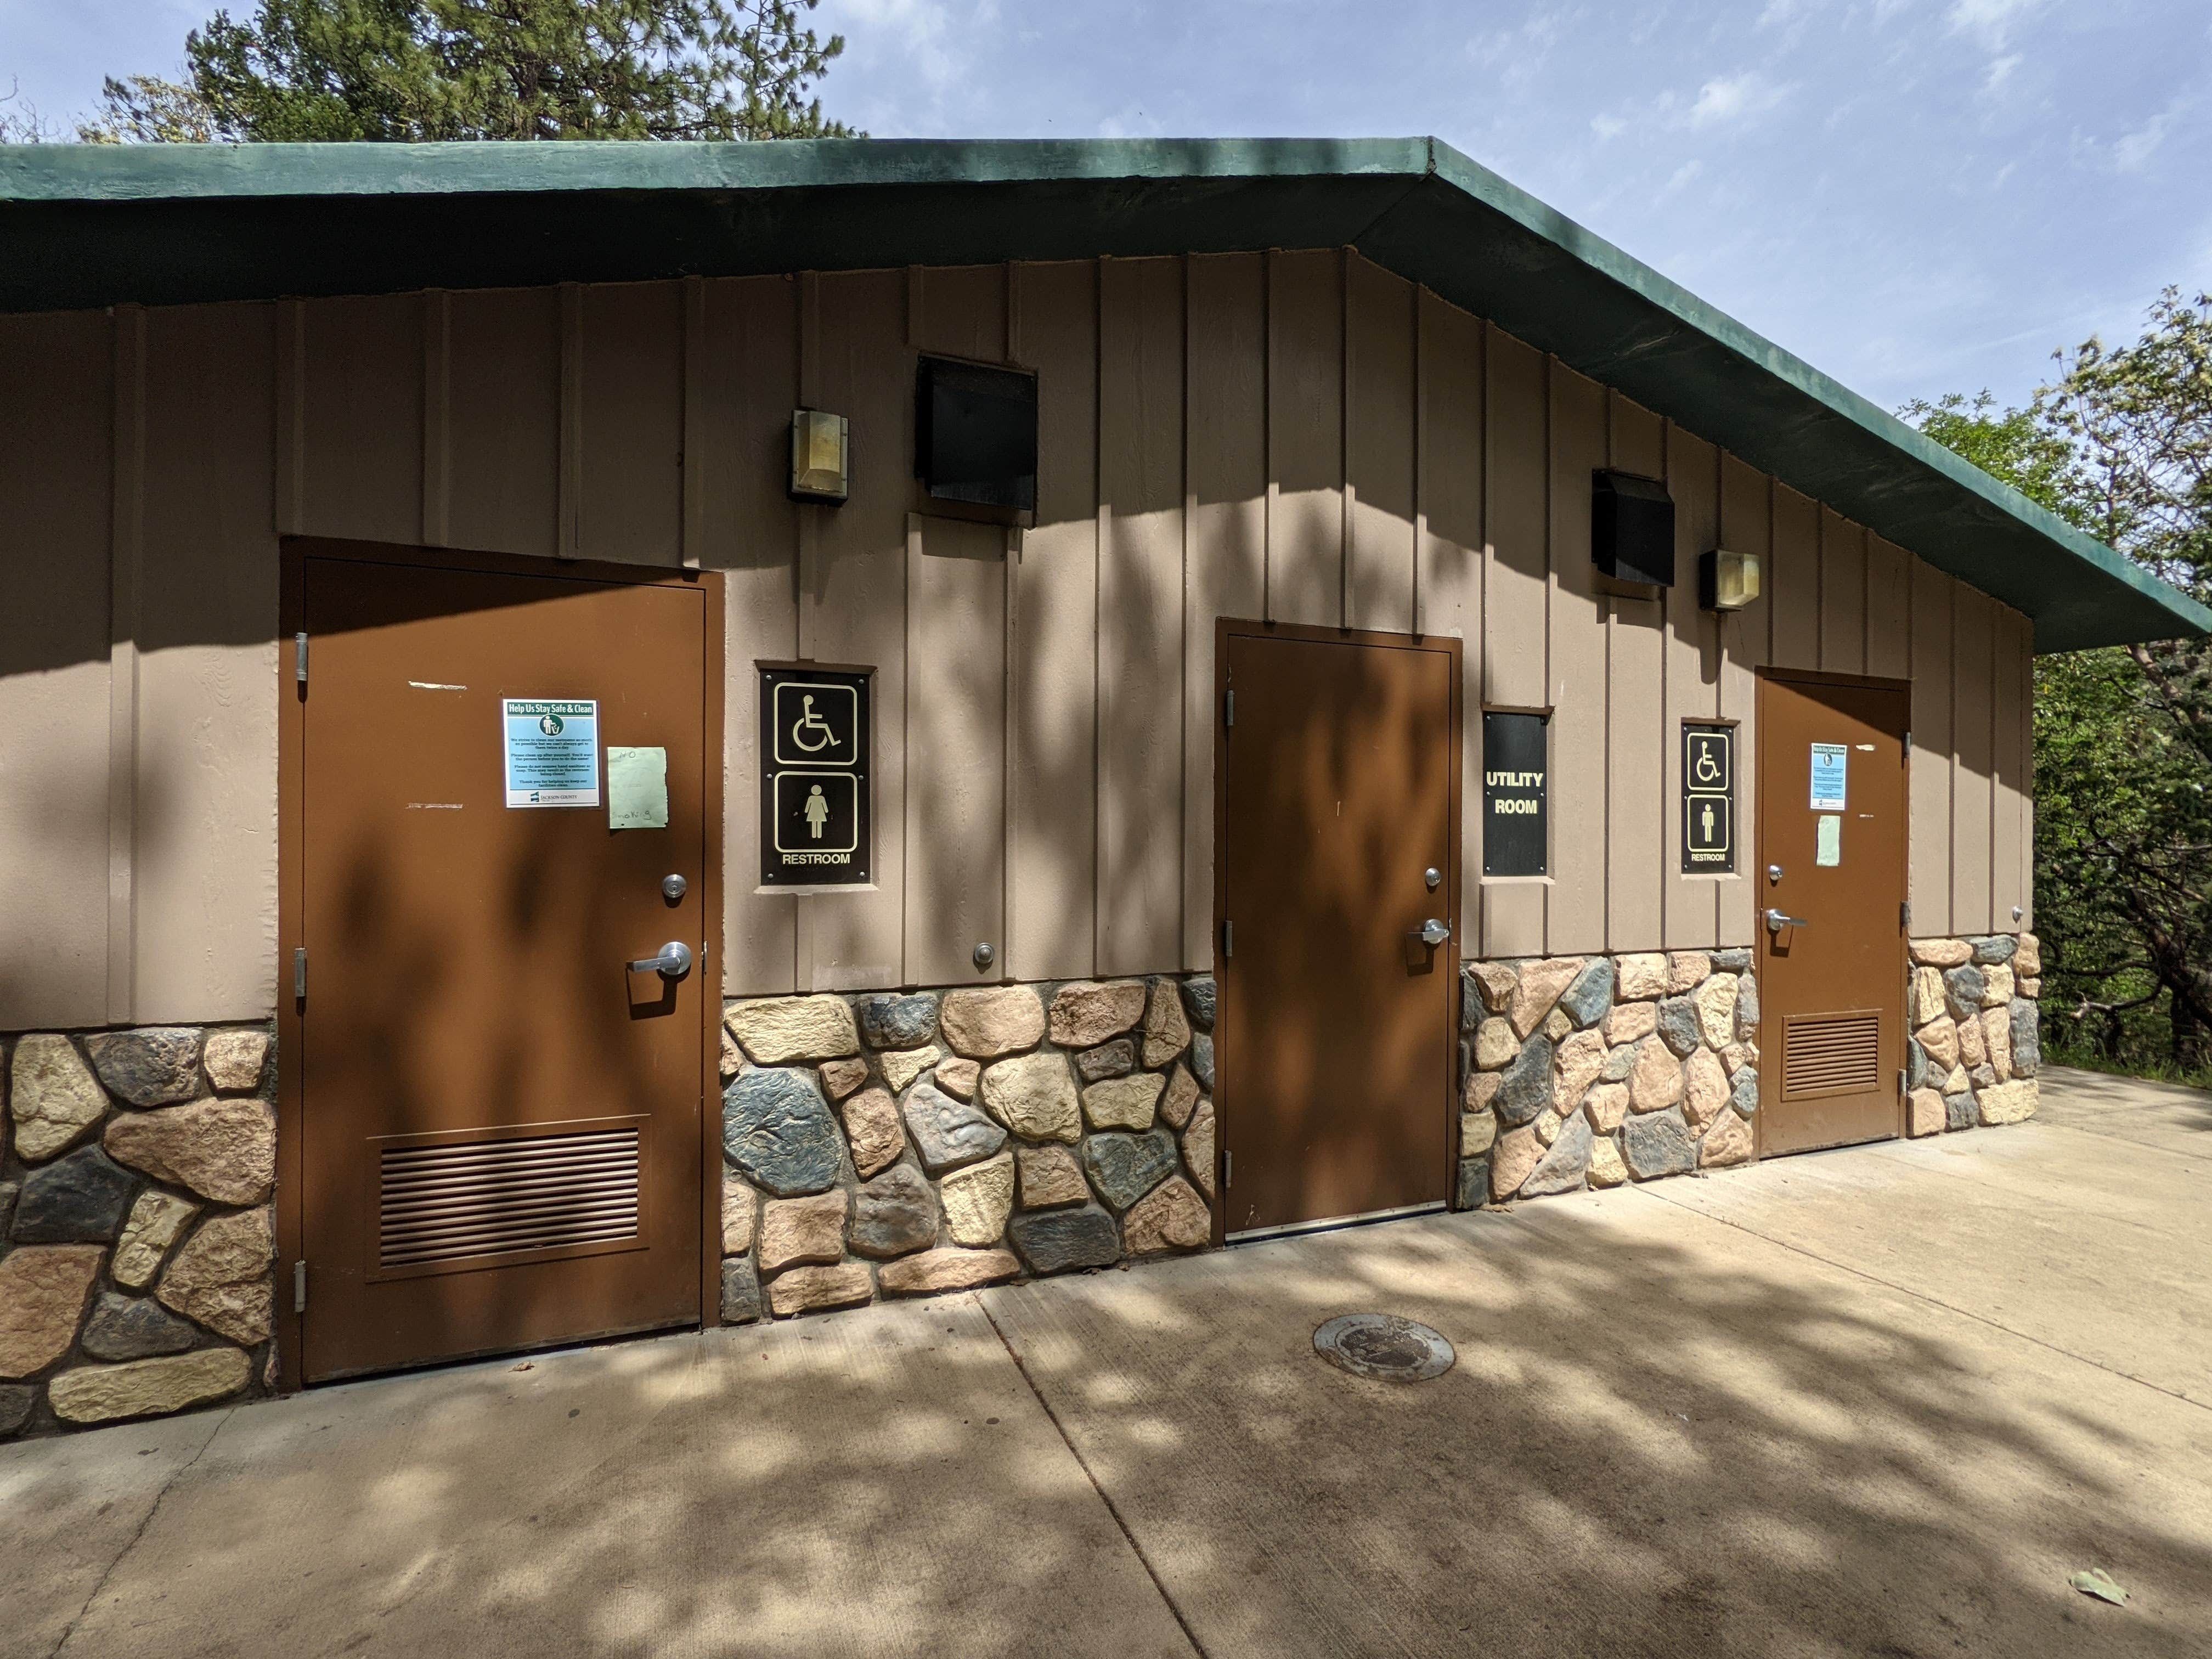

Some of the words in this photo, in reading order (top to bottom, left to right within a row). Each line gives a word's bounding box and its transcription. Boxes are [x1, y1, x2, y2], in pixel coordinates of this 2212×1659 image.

[509, 704, 524, 714] Help
[526, 704, 535, 712] Us
[535, 704, 551, 714] Stay
[551, 704, 566, 713] Safe
[567, 704, 574, 713] &
[574, 704, 592, 713] Clean
[1486, 771, 1543, 787] UTILITY
[1495, 799, 1537, 814] ROOM
[782, 854, 850, 864] RESTROOM
